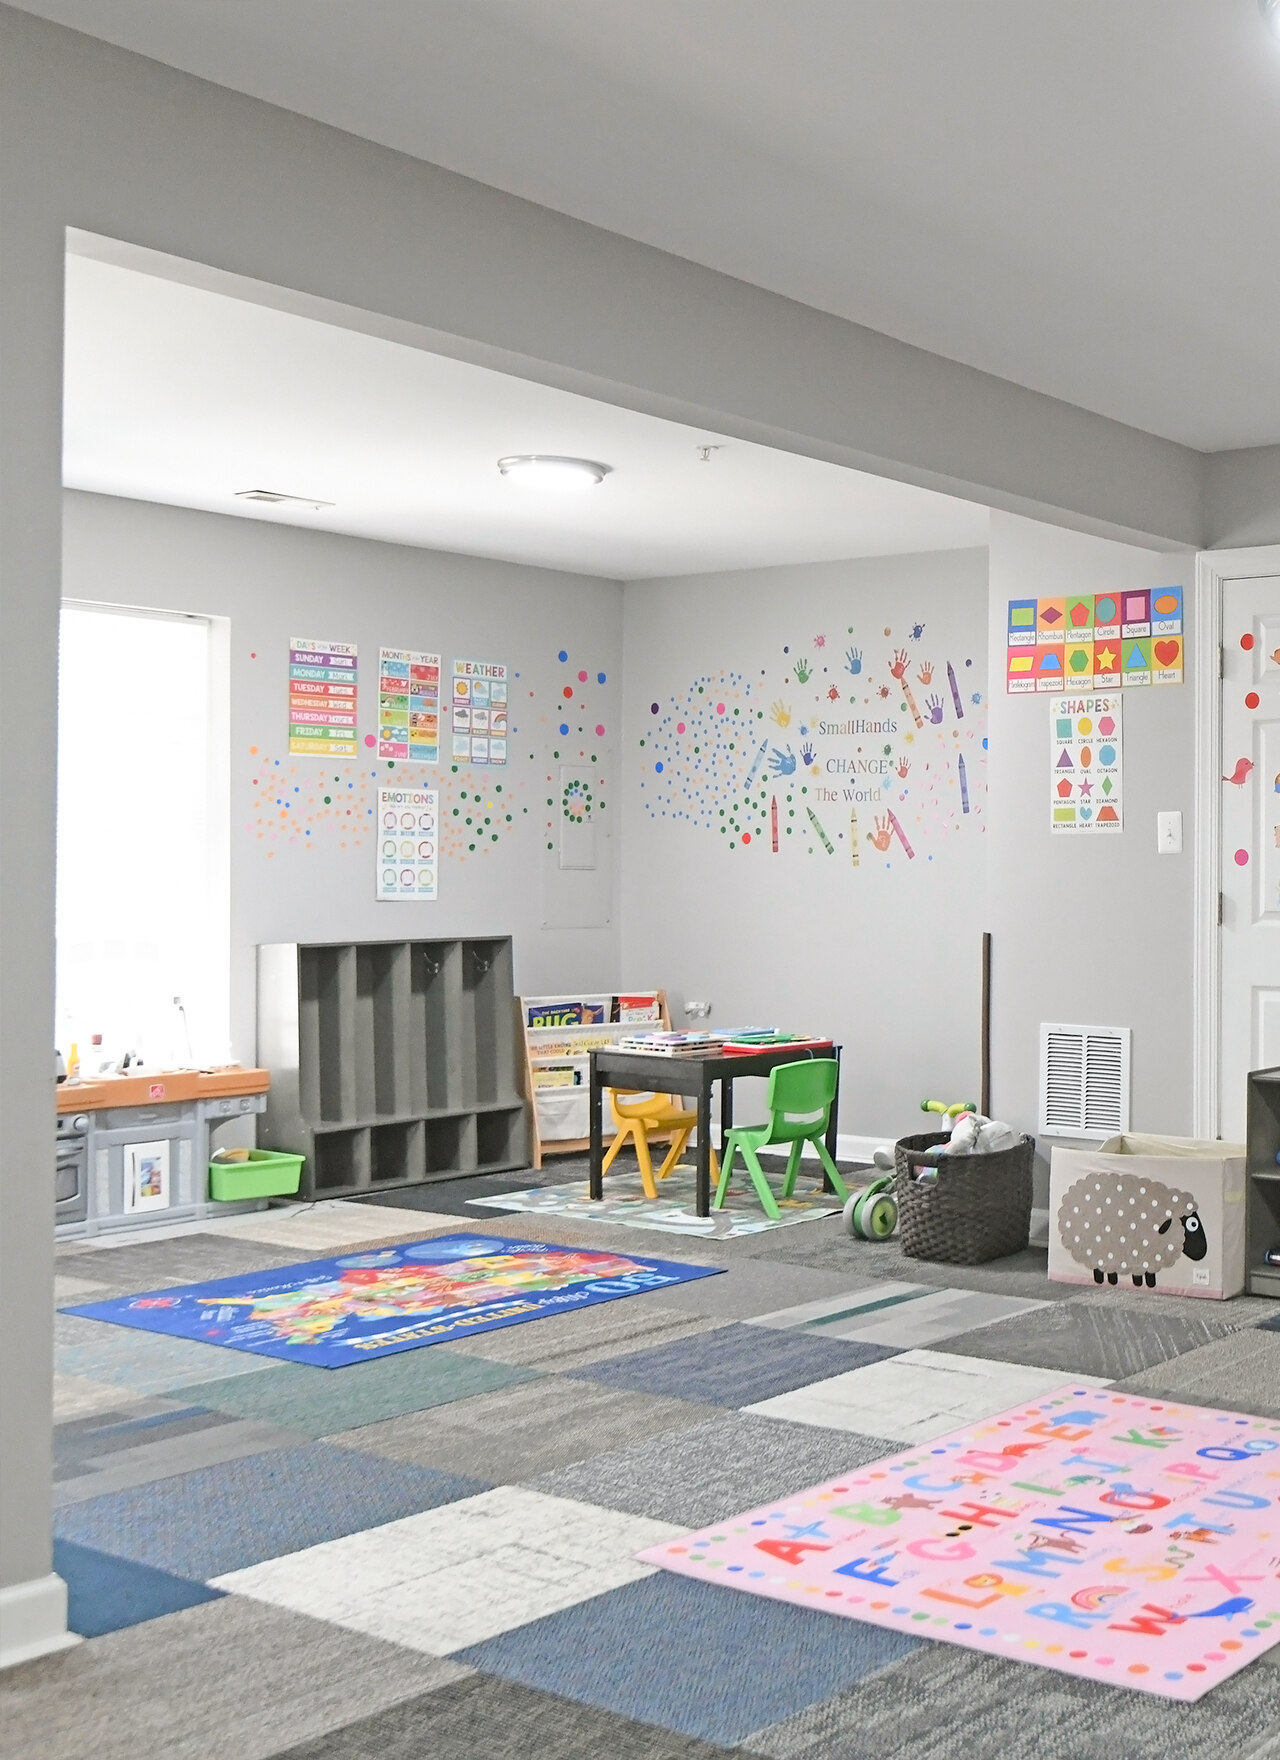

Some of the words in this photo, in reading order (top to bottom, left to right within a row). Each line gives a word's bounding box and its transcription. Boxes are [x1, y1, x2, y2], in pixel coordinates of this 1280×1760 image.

[1097, 627, 1115, 637] Circle
[1126, 624, 1147, 636] Square
[1158, 621, 1174, 631] Oval
[1010, 632, 1035, 645] Rectangle
[1038, 631, 1063, 641] Rhombus
[1066, 630, 1092, 642] Pentagon
[329, 644, 351, 654] WEEK
[294, 653, 324, 665] SUNDAY
[420, 655, 439, 665] YEAR
[293, 668, 326, 679] MONDAY
[456, 662, 505, 678] WEATHER
[1126, 672, 1149, 684] Triangle
[1158, 669, 1176, 680] Heart
[1066, 677, 1091, 688] Hexagon
[1101, 673, 1114, 684] Star
[293, 683, 325, 694] TUESDAY
[1060, 698, 1110, 715] SHAPES
[291, 711, 328, 722] THURSDAY
[296, 726, 324, 737] FRIDAY
[819, 718, 898, 735] SmallHands
[826, 758, 889, 775] CHANGE
[382, 791, 434, 805] EMOTIONS
[815, 787, 838, 802] The
[842, 787, 881, 802] World
[583, 1271, 680, 1294] 50
[454, 1302, 544, 1327] UNITED
[353, 1325, 449, 1350] STATES
[1111, 1428, 1184, 1449] K
[1195, 1446, 1262, 1462] Q
[1162, 1462, 1220, 1481] P
[754, 1538, 834, 1565] A
[827, 1503, 903, 1527] B
[903, 1473, 965, 1493] C
[1023, 1421, 1093, 1442] E
[1099, 1489, 1172, 1511] O
[938, 1501, 1020, 1528] H
[1031, 1505, 1113, 1535] N
[906, 1538, 977, 1561] G
[991, 1547, 1086, 1579] M
[1025, 1602, 1112, 1630] R
[1104, 1557, 1179, 1582] S
[1163, 1512, 1236, 1535] T
[1200, 1489, 1272, 1511] U
[832, 1557, 901, 1588] F
[919, 1587, 1004, 1610] L
[1107, 1603, 1188, 1637] W
[1184, 1563, 1266, 1595] X
